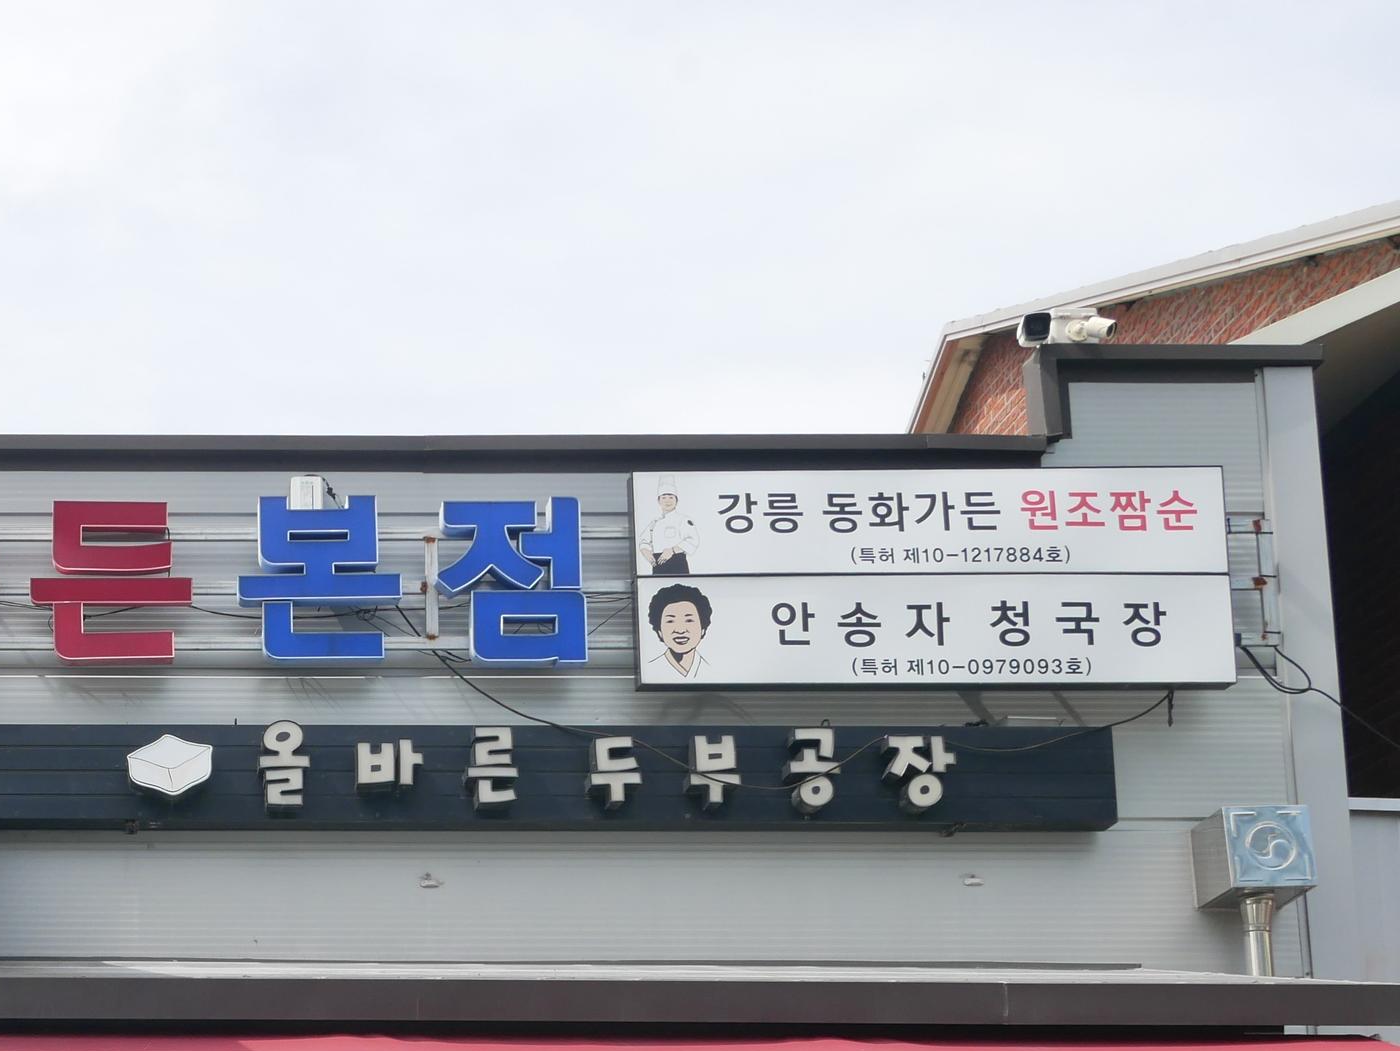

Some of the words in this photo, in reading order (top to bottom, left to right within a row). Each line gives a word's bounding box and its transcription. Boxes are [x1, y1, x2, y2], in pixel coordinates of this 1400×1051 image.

[717, 492, 804, 534] 강릉
[822, 491, 1002, 533] 동화가든
[1020, 489, 1199, 532] 원조짬순
[850, 545, 896, 566] (특허
[903, 545, 1071, 566] 제10-1217884호)
[238, 495, 588, 667] 본점
[770, 601, 951, 647] 안송자
[990, 601, 1168, 648] 청국장
[851, 656, 899, 678] (특허
[906, 656, 1092, 678] 제10-0979093호)
[258, 719, 522, 811] 올바른
[585, 728, 958, 815] 두부공장
